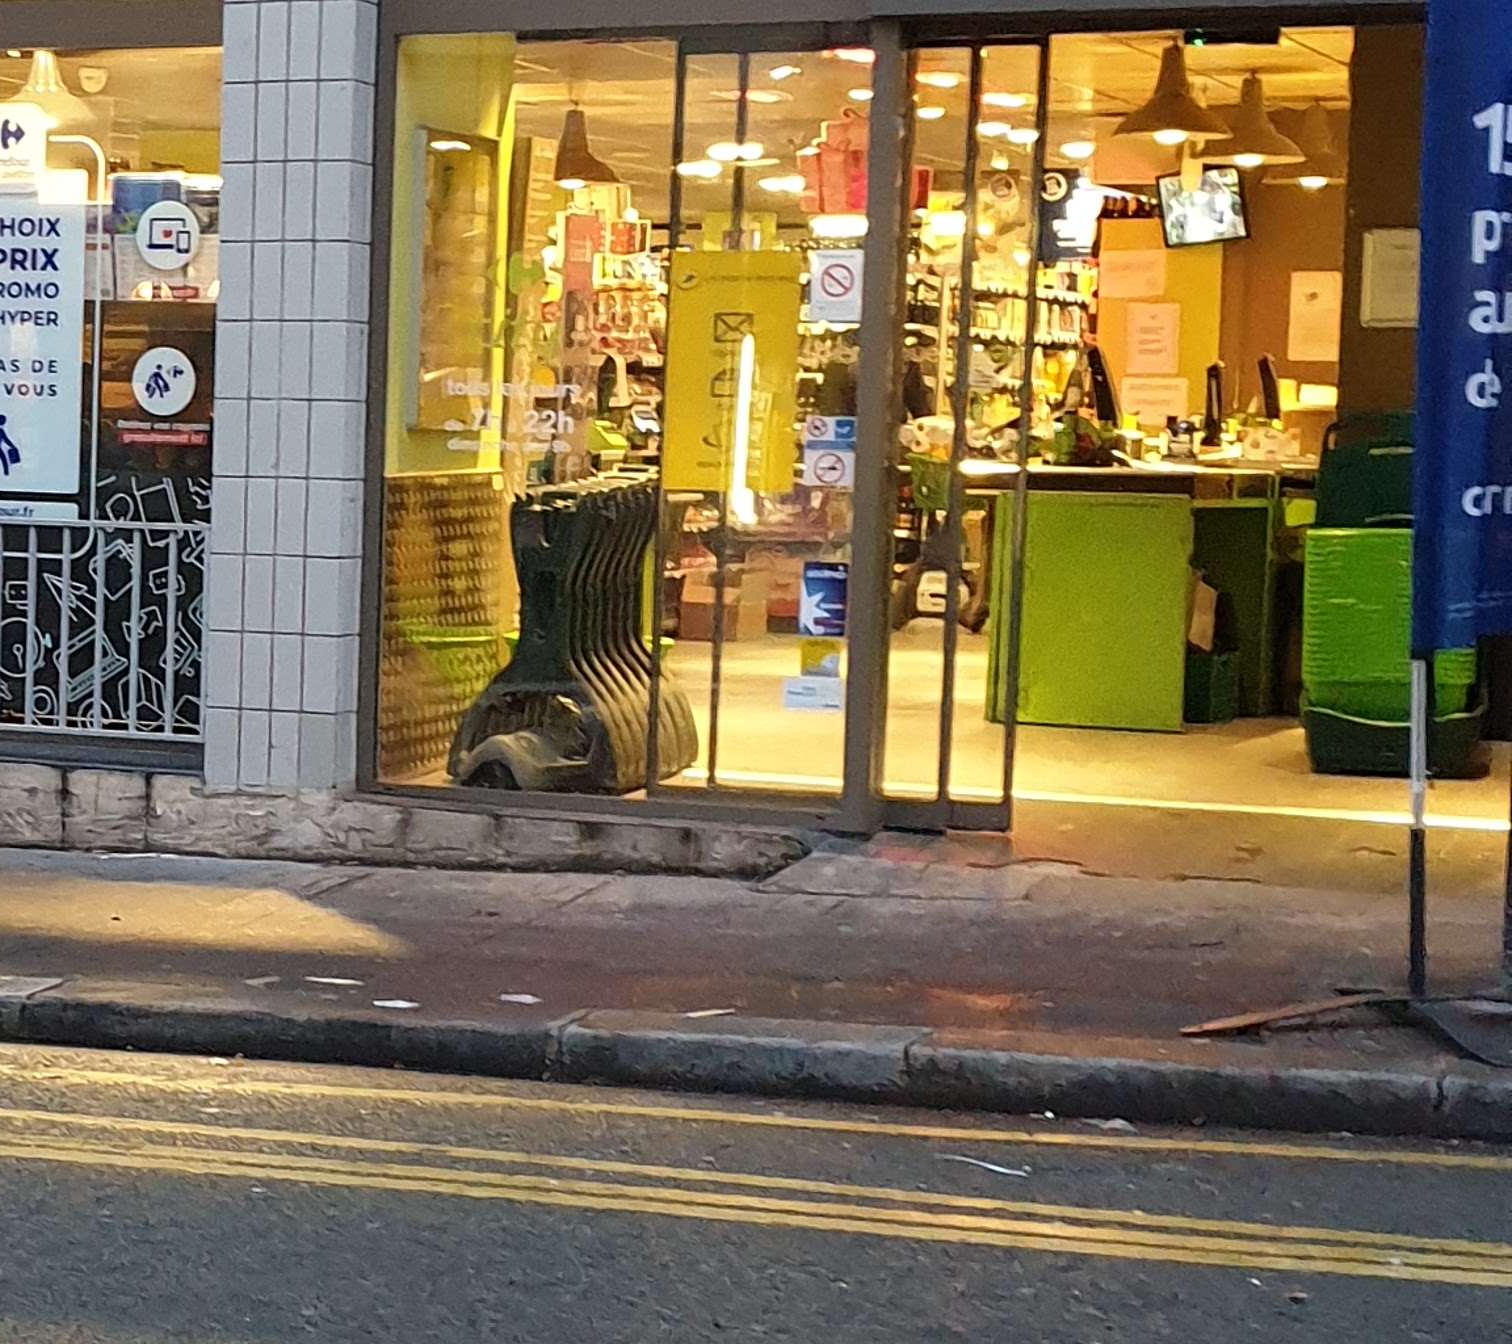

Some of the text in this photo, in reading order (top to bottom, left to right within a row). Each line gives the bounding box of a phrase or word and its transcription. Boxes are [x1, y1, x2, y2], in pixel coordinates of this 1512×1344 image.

[31, 359, 59, 374] DE
[4, 383, 58, 397] VOUS
[523, 409, 575, 435] 22h
